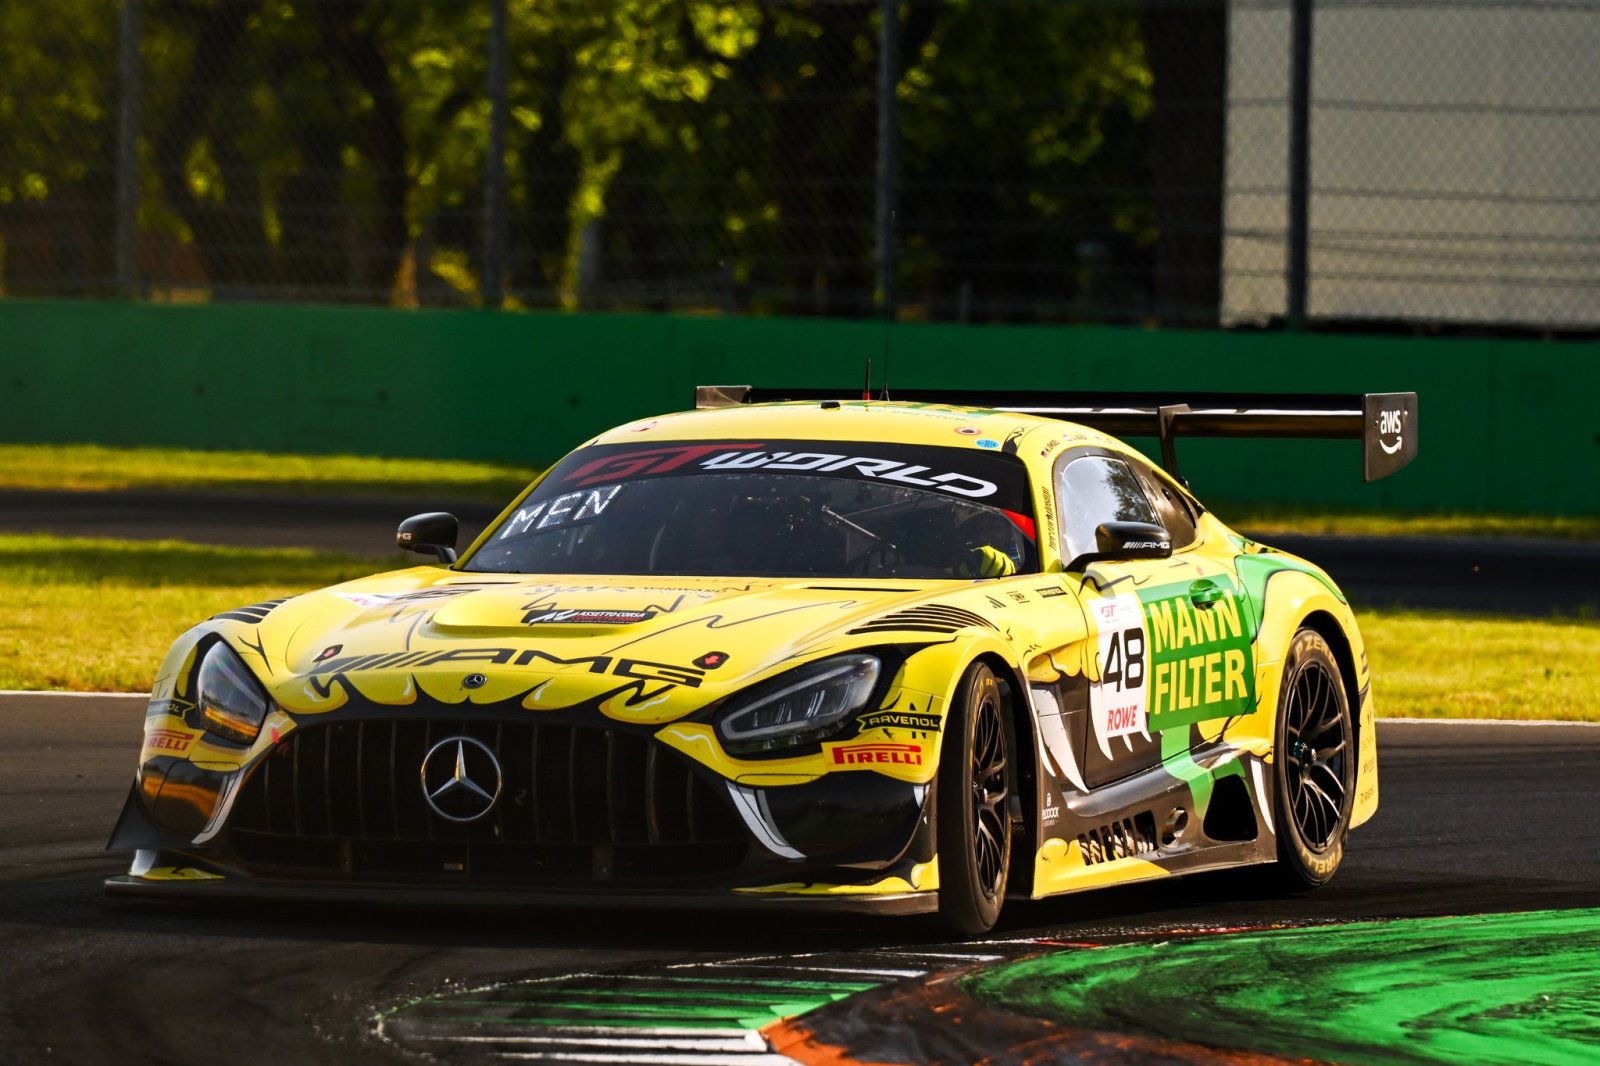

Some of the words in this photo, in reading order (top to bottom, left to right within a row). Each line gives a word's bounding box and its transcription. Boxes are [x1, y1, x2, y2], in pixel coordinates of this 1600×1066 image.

[1380, 410, 1402, 434] aws
[559, 443, 766, 487] GT
[699, 451, 998, 498] WORLD
[500, 484, 623, 540] MEN
[1142, 541, 1170, 549] AMG
[1148, 588, 1242, 654] MANN
[413, 648, 706, 689] AMG
[1102, 627, 1145, 693] 48
[1154, 648, 1248, 715] FILTER
[868, 714, 939, 727] RAVENOL
[1106, 704, 1138, 732] ROWE
[832, 743, 922, 766] PIRELLI
